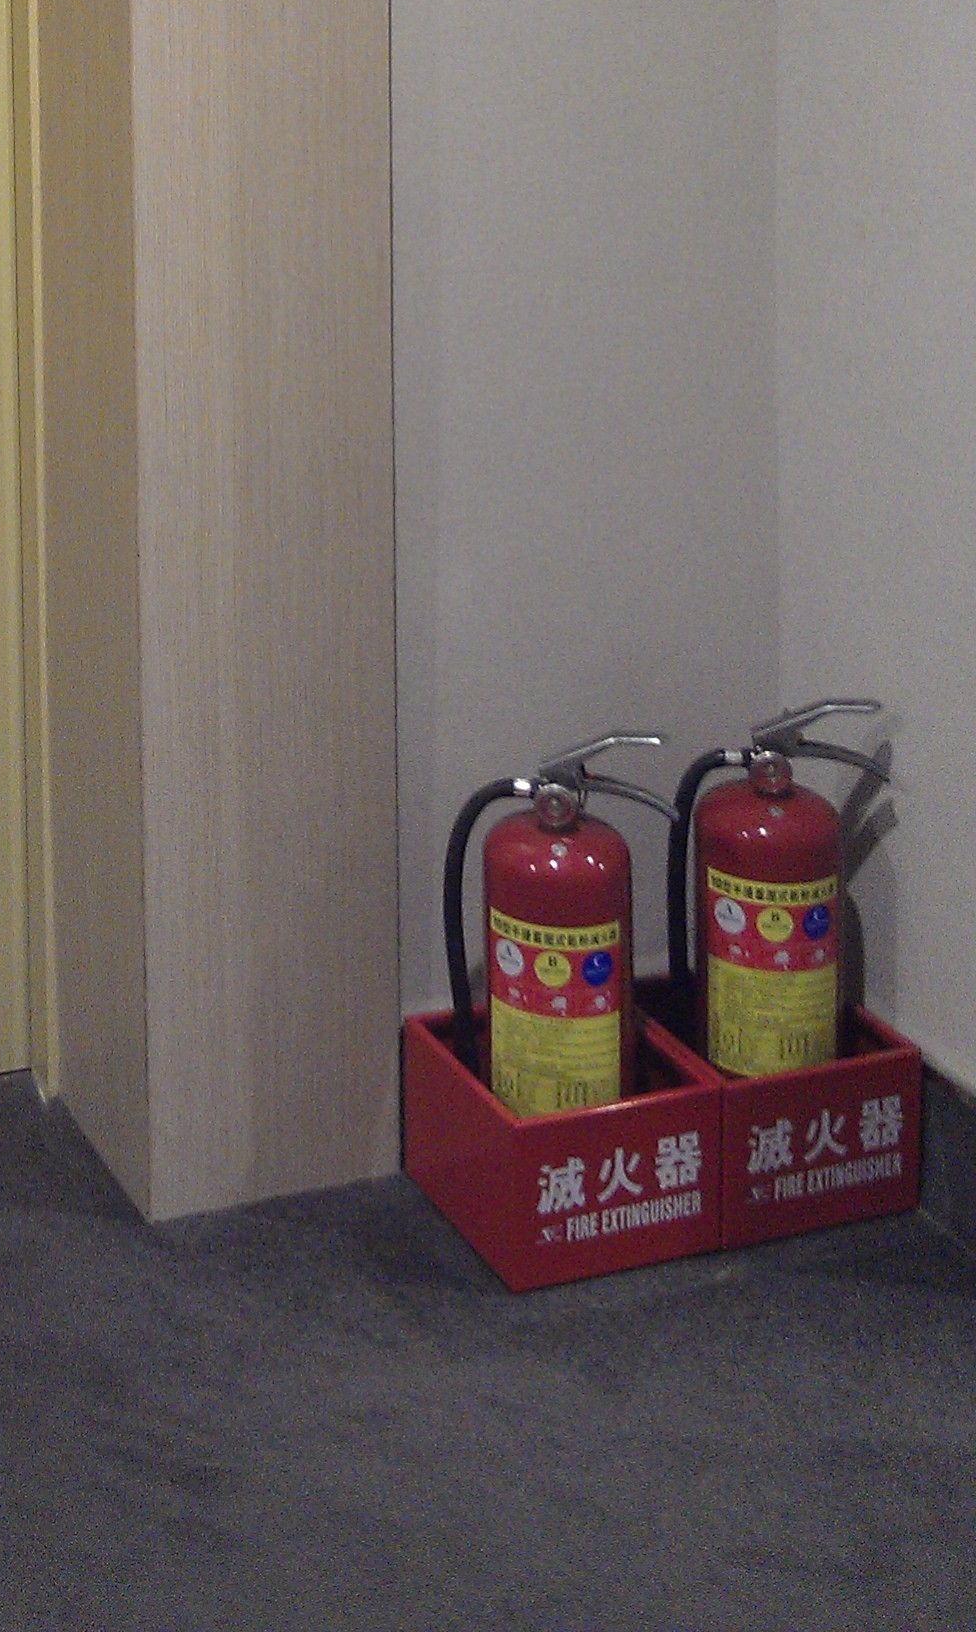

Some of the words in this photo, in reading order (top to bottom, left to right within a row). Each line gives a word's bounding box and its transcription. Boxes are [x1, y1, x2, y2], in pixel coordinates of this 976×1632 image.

[746, 1094, 904, 1174] 滅火器
[536, 1129, 703, 1214] 滅火器
[774, 1171, 804, 1202] FIRE
[806, 1151, 903, 1195] EXTINGUISHER
[565, 1211, 599, 1243] FIRE
[600, 1189, 703, 1236] EXTINGUISHER
